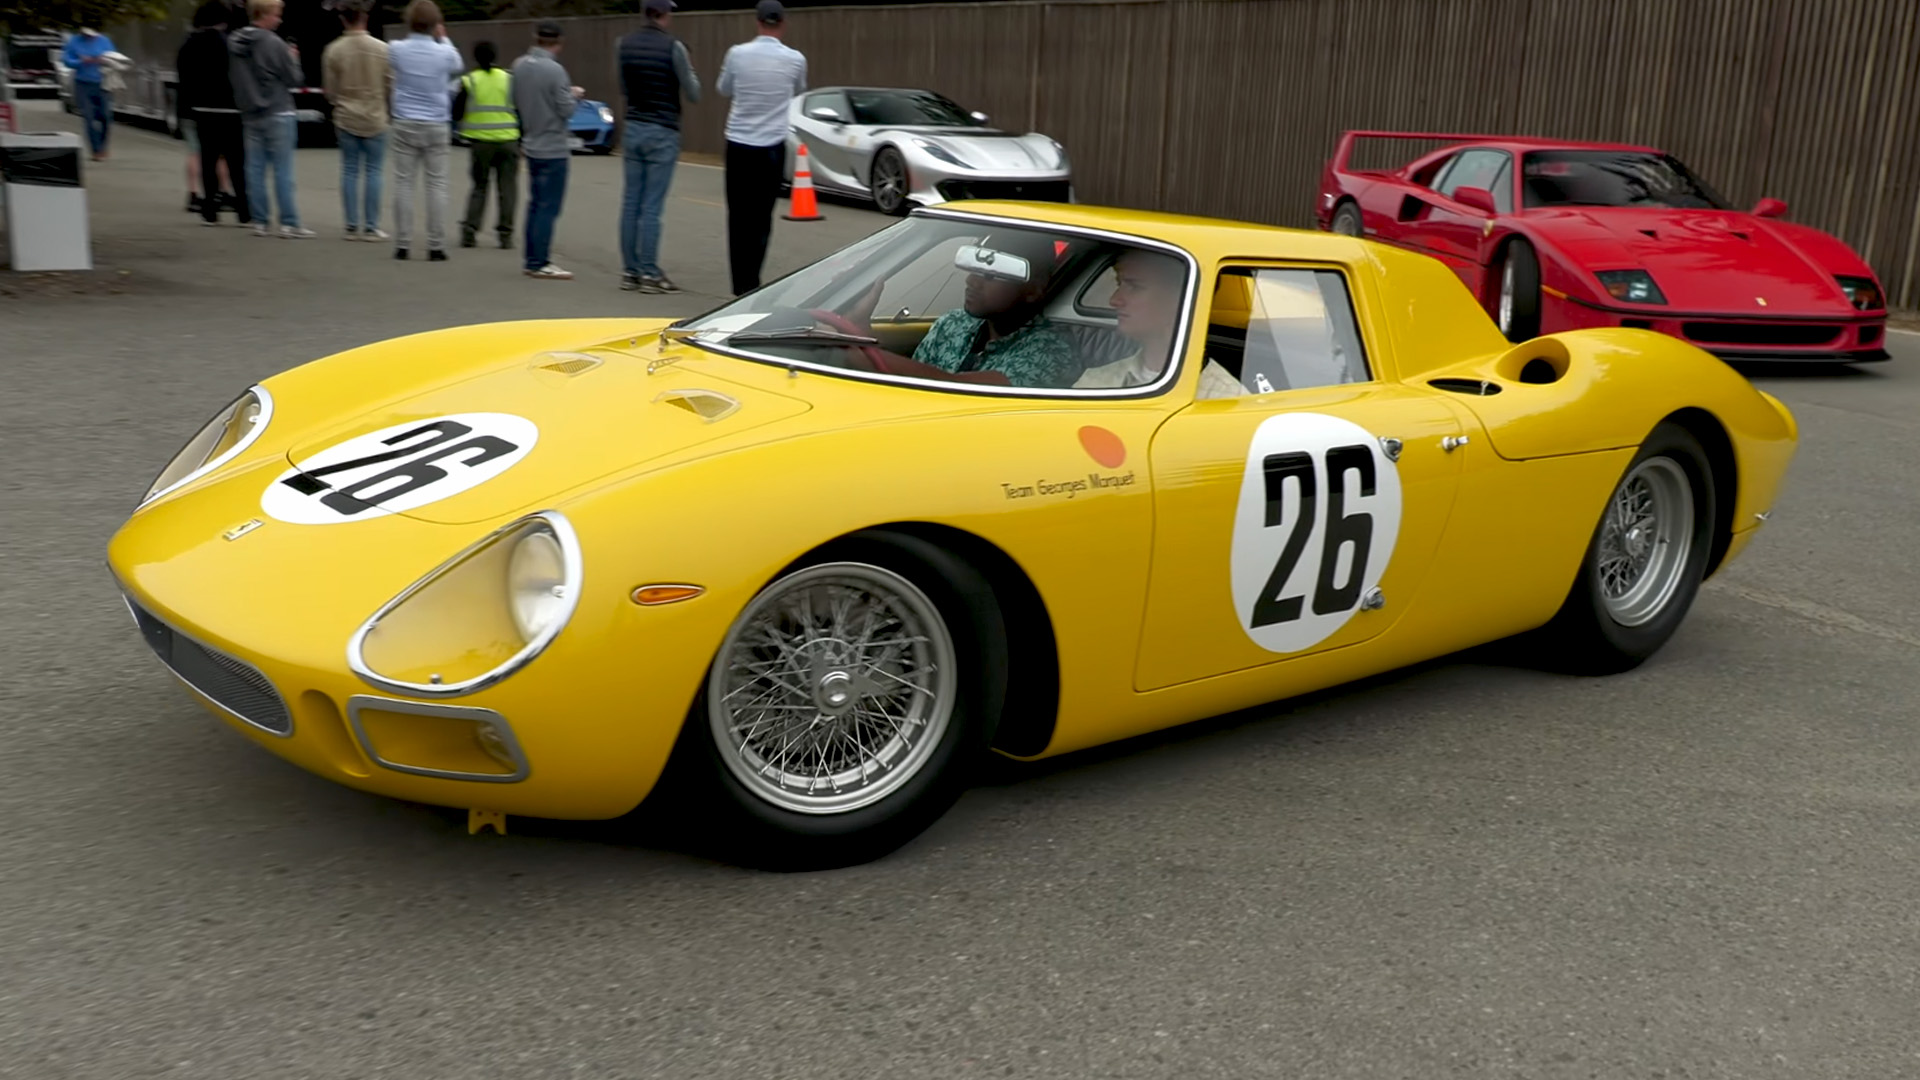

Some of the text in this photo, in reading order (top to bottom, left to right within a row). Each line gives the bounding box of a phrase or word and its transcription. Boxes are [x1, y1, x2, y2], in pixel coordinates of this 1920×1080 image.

[280, 419, 519, 516] 26
[1001, 482, 1035, 499] Team
[1037, 479, 1087, 498] Georges
[1250, 443, 1376, 629] 26
